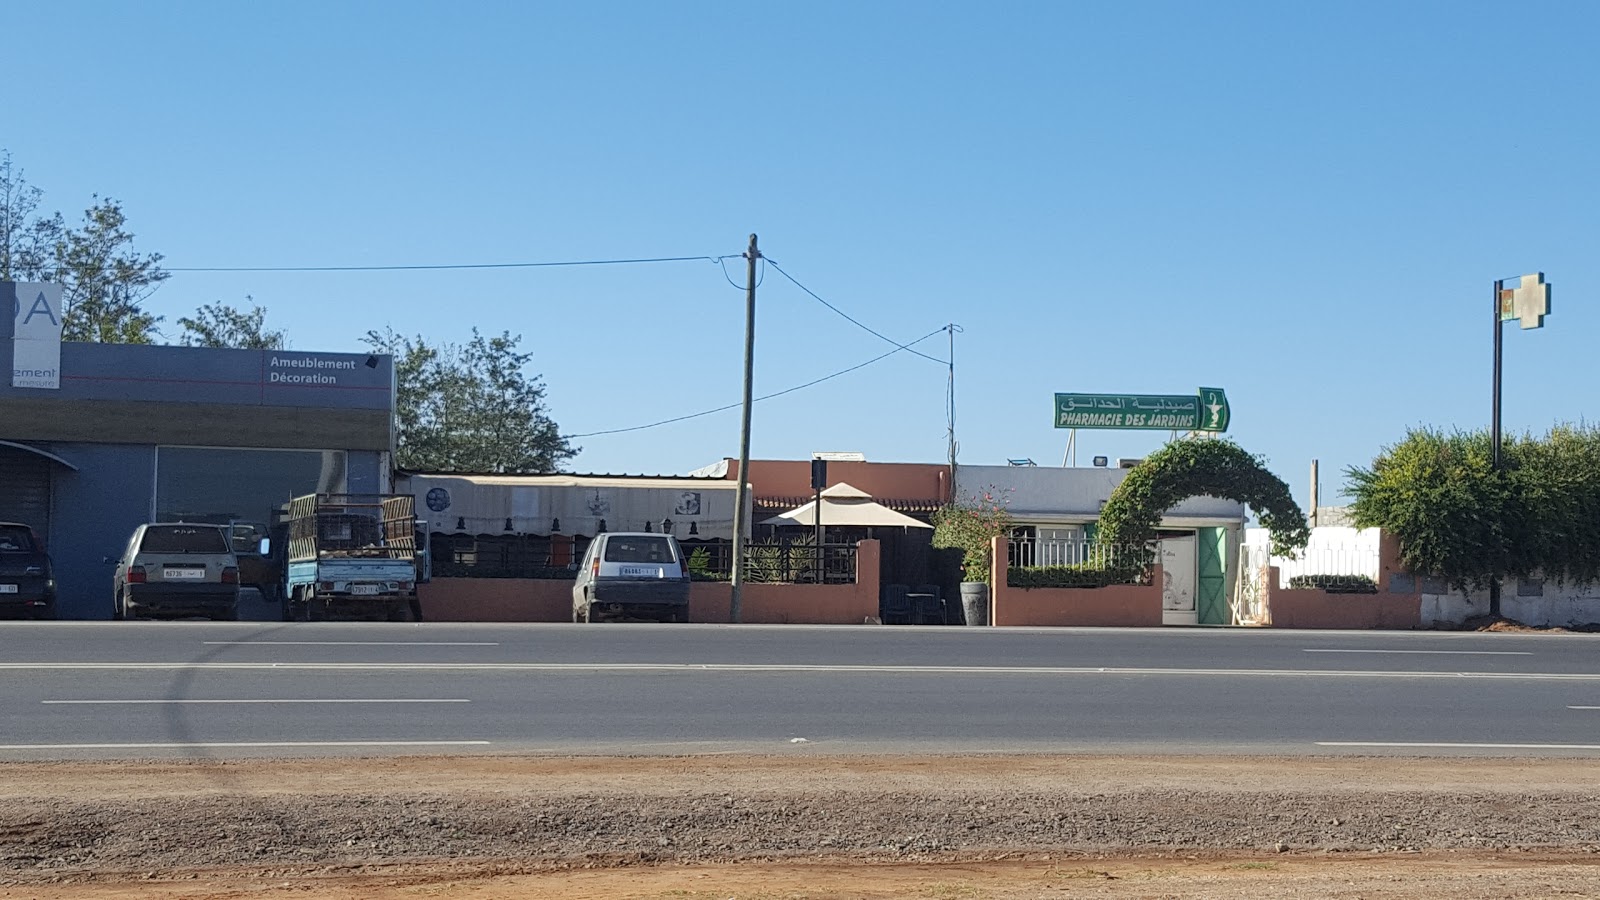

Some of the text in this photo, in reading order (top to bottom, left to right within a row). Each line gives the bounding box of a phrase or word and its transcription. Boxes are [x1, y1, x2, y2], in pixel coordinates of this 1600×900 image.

[270, 356, 356, 370] Ameublement
[270, 372, 336, 384] Décoration
[1060, 412, 1195, 427] PHARMACIE DES JARDINS
